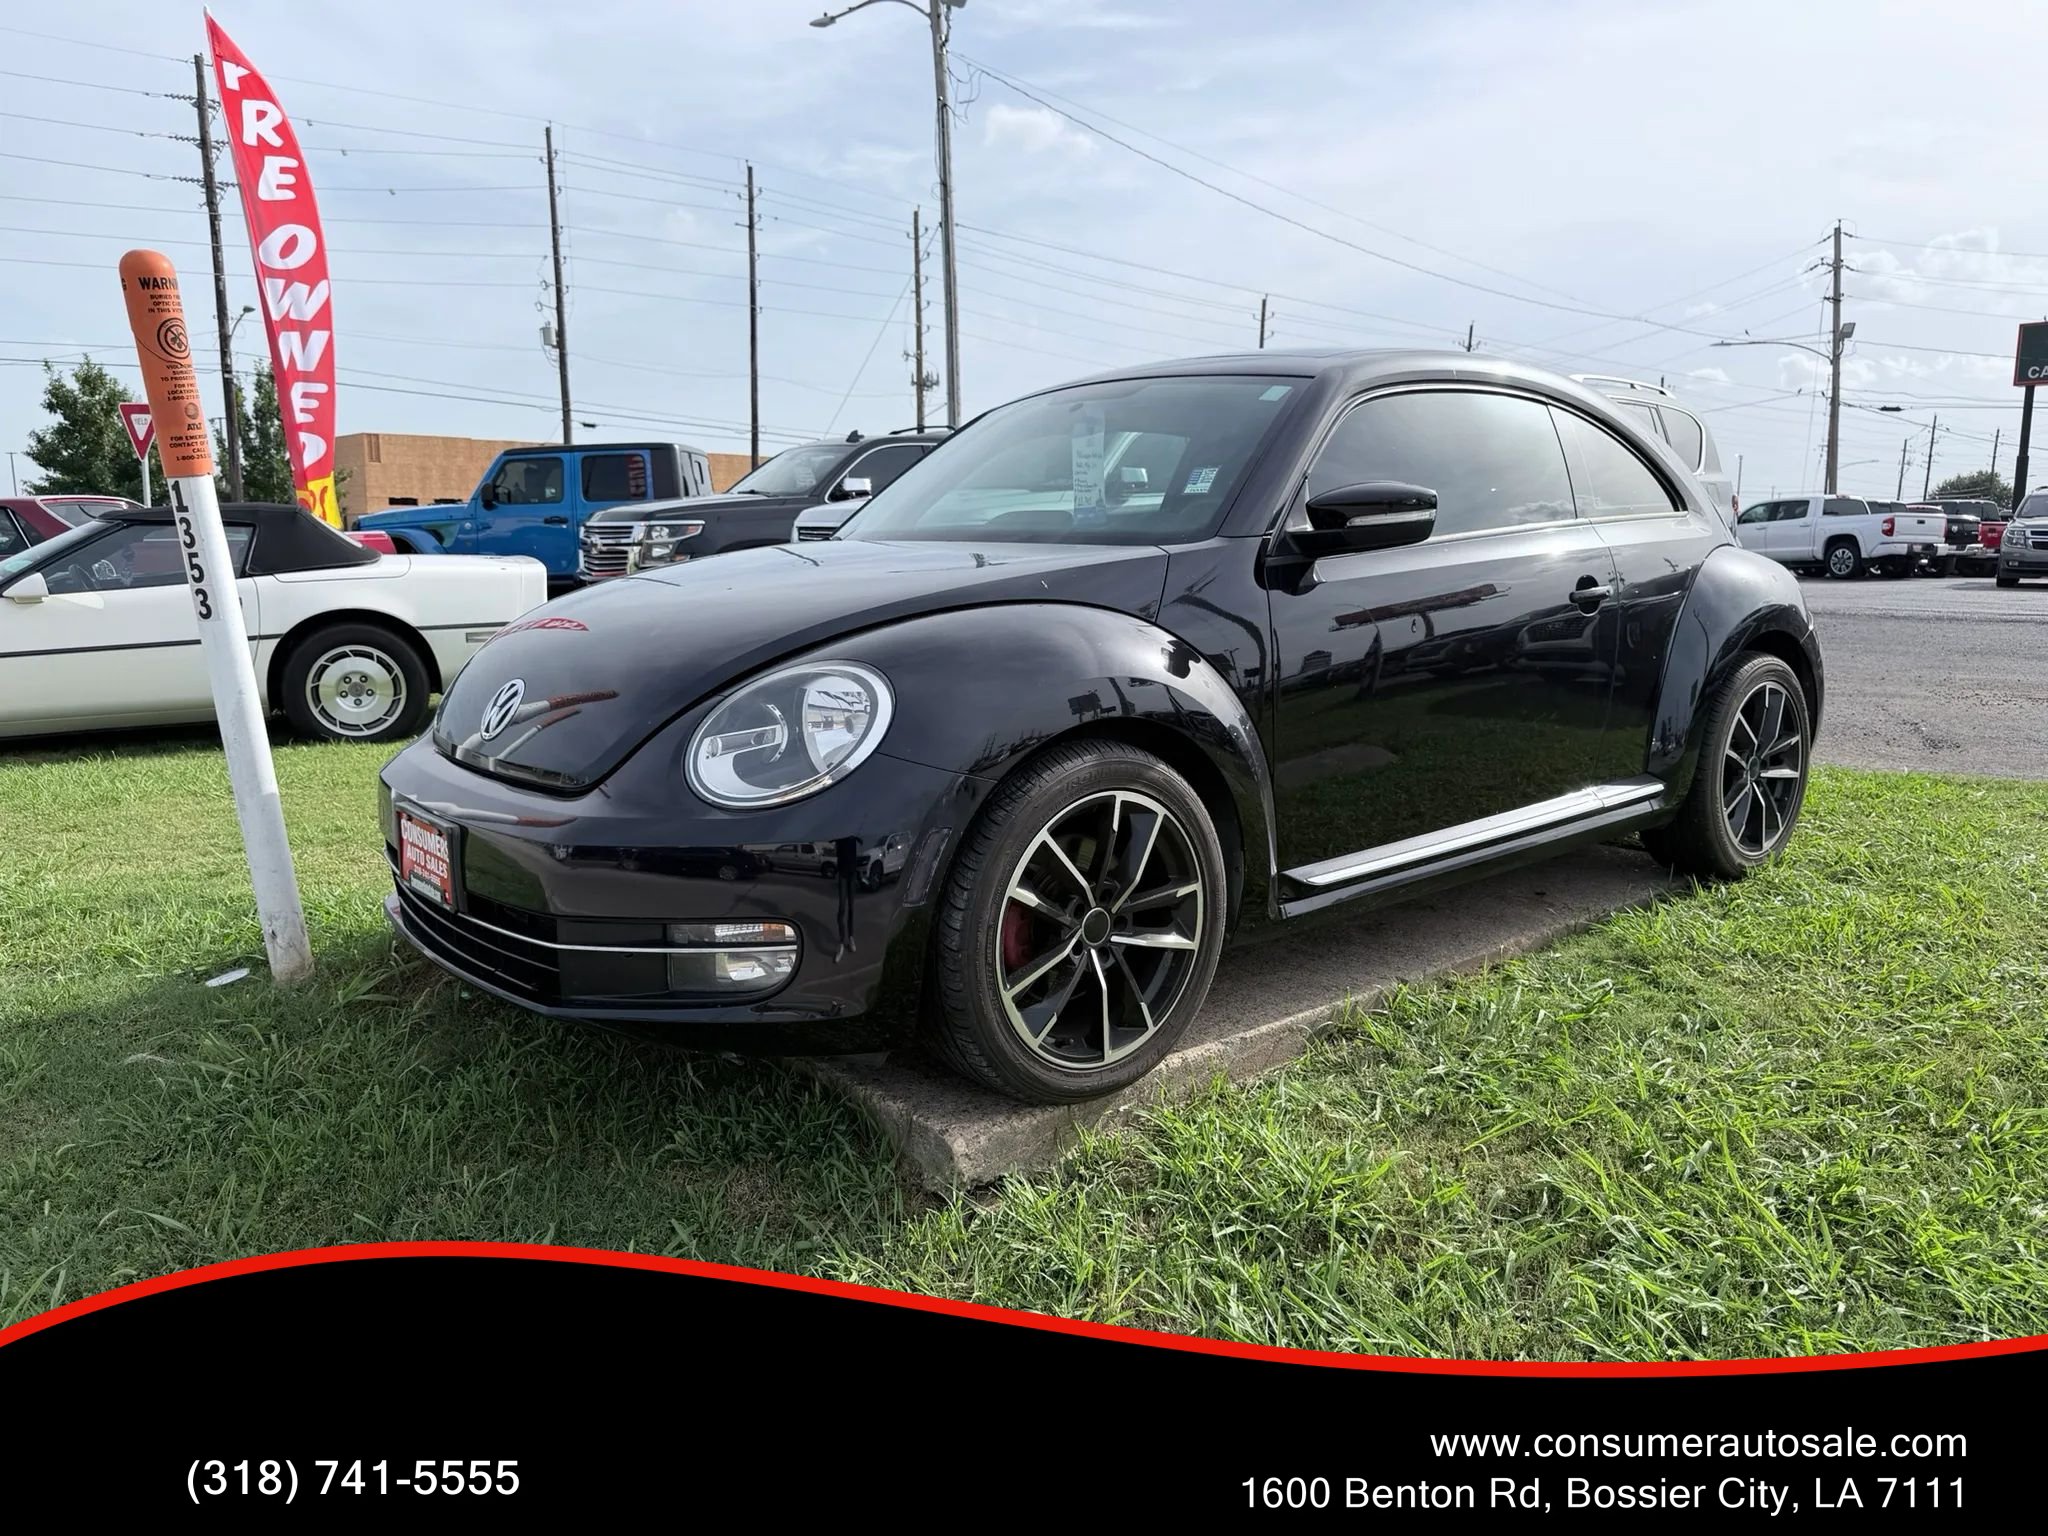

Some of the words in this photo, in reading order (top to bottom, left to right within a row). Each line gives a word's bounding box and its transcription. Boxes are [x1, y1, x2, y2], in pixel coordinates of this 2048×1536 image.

[171, 480, 212, 620] 1353
[406, 844, 425, 867] AUTO
[425, 853, 448, 879] SALES
